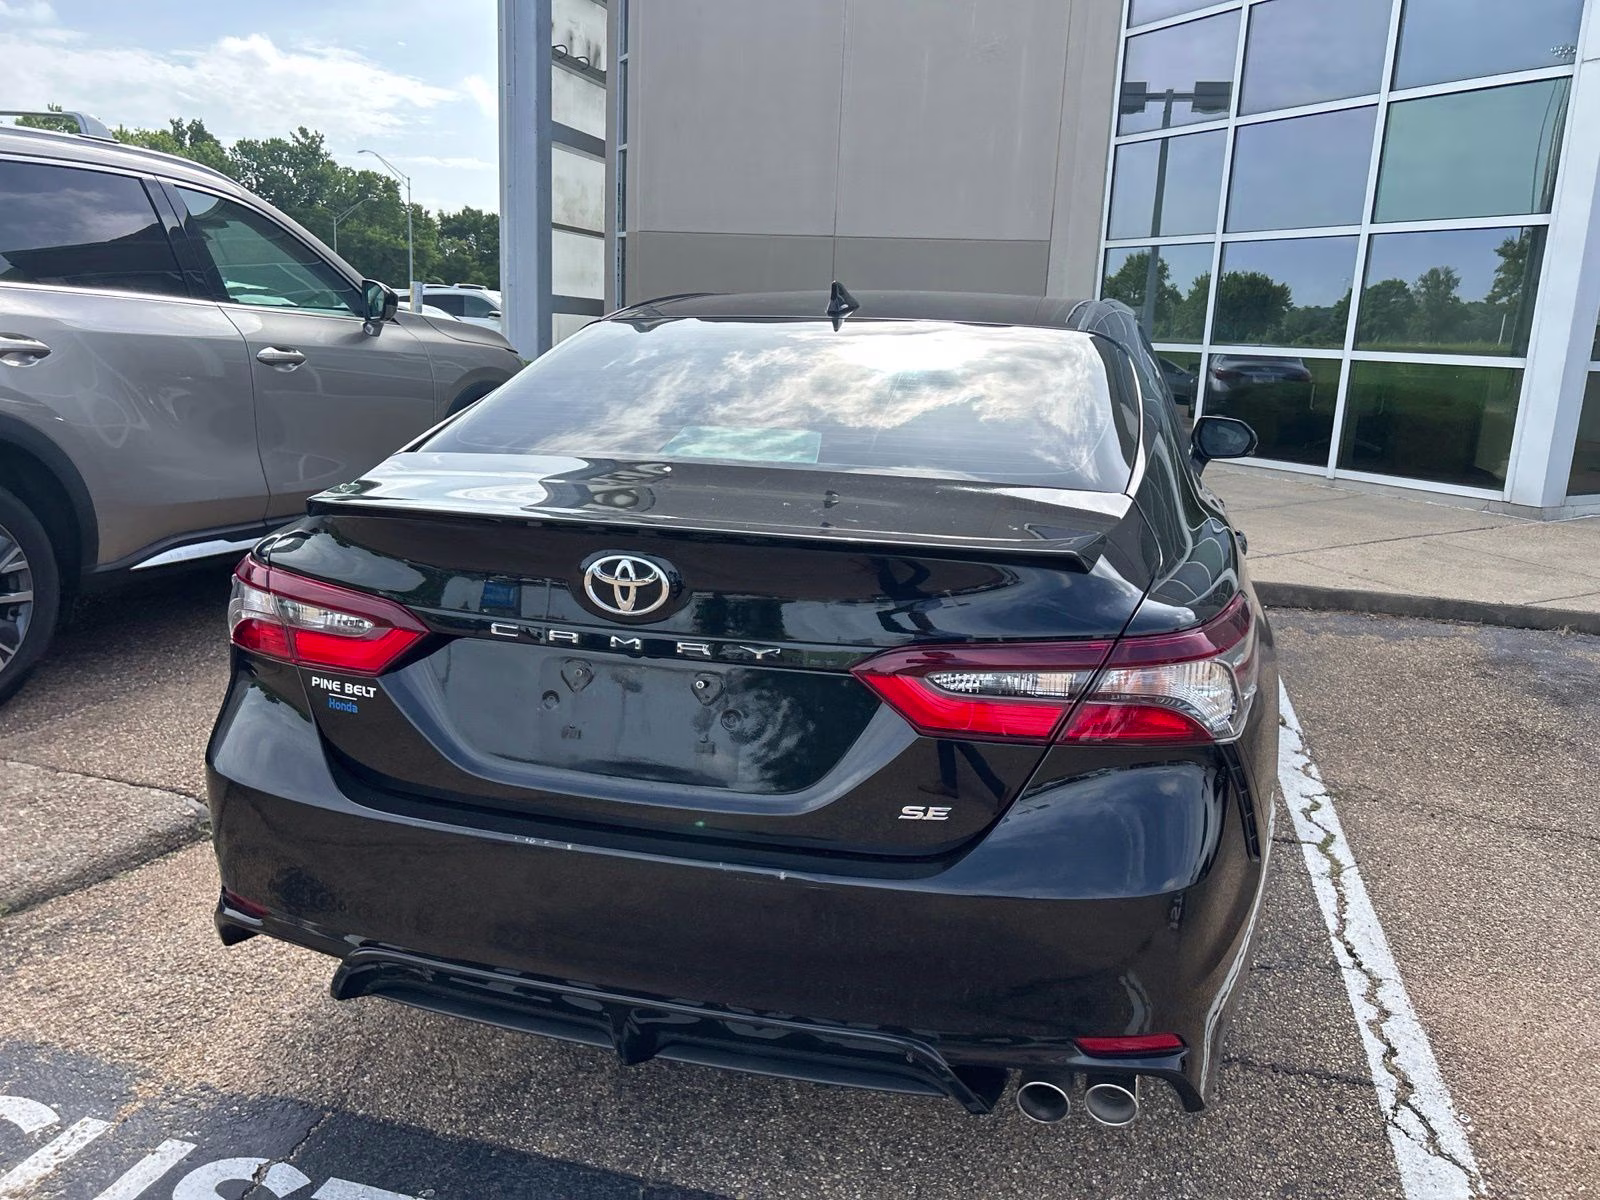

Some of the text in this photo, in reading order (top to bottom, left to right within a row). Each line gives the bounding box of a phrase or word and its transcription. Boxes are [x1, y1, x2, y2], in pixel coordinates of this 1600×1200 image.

[490, 621, 781, 660] CAMRY
[311, 676, 377, 698] PINE BELT
[328, 697, 358, 713] Honda
[898, 805, 953, 821] SE
